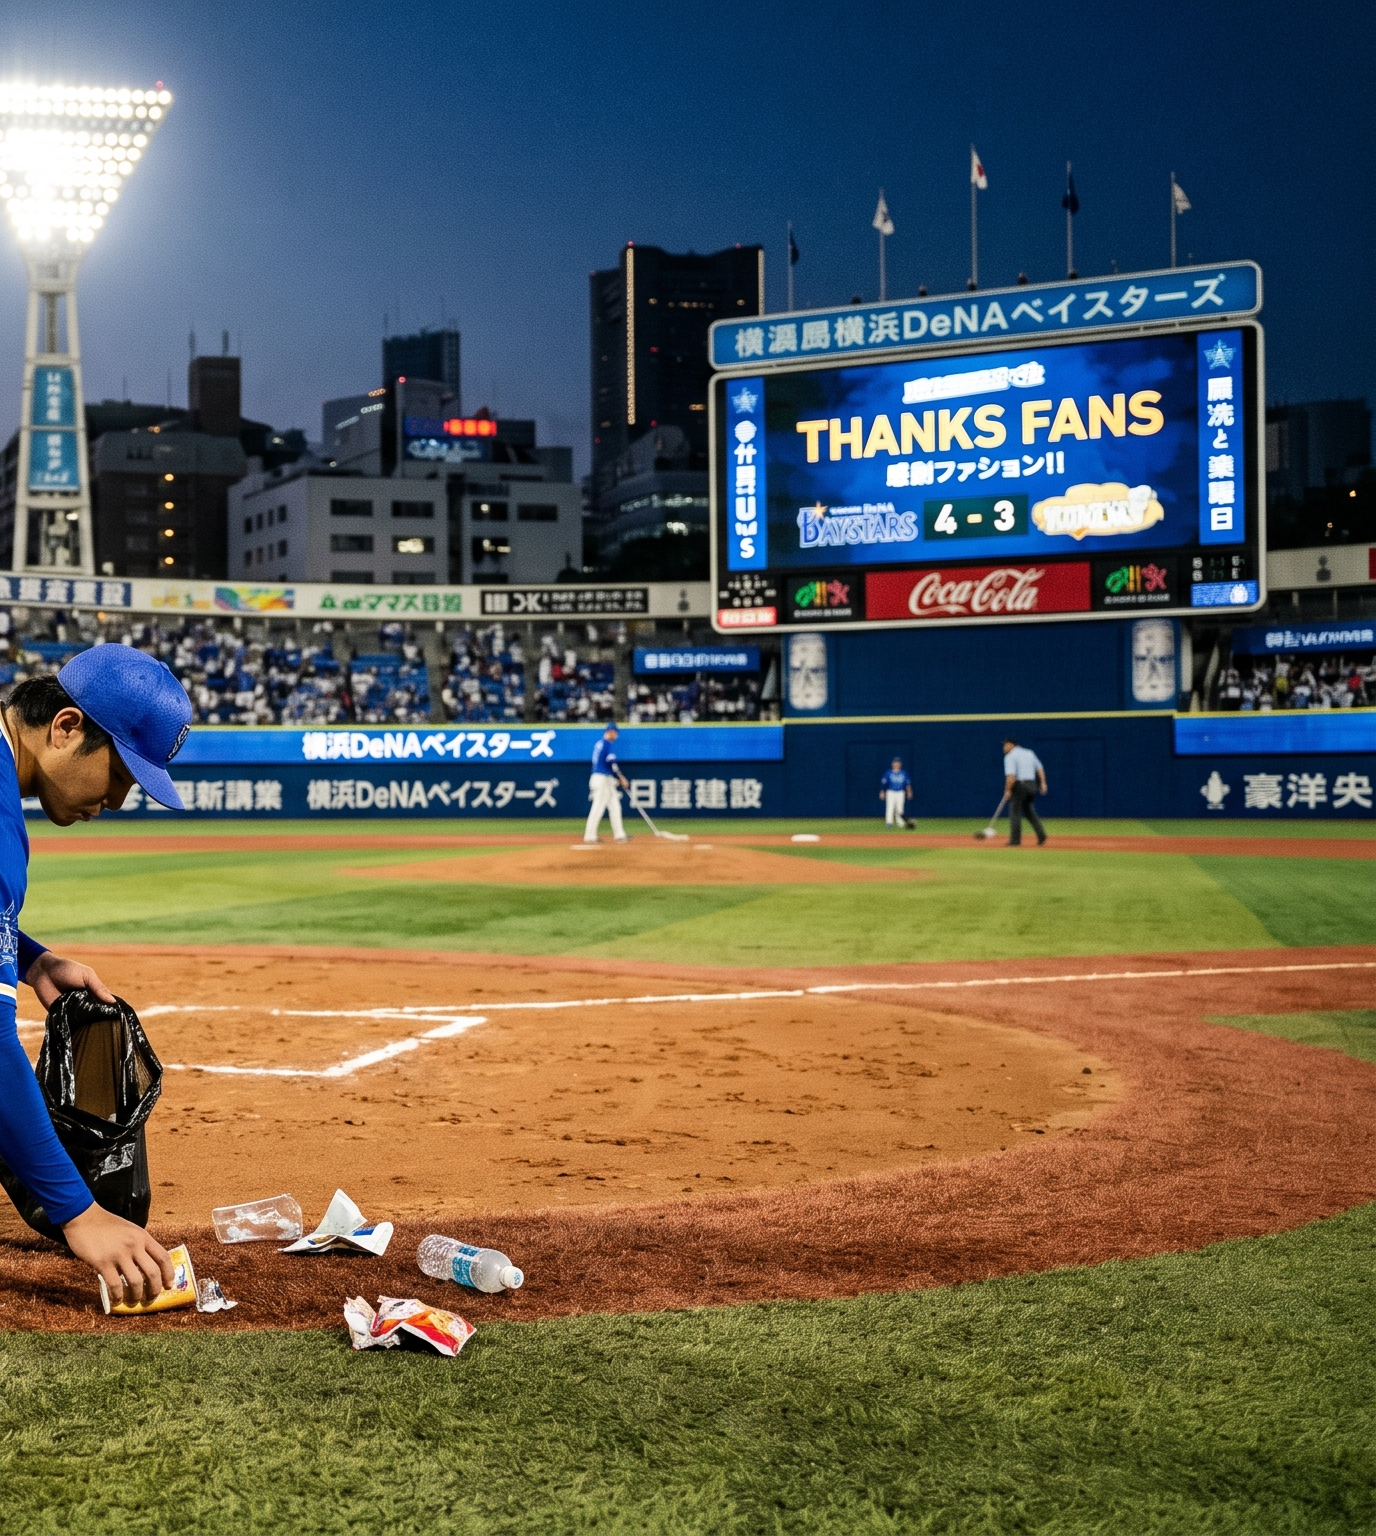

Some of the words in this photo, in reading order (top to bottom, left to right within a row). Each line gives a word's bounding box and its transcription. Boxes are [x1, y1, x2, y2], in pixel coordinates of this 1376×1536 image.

[796, 404, 1007, 463] THANKS
[1022, 390, 1165, 444] FANS
[797, 506, 919, 548] BAYSTARS
[934, 503, 958, 534] 4
[993, 500, 1016, 532] 3
[908, 567, 1046, 616] Coca-Cola
[302, 730, 557, 760] 横浜DeNAベイスターズ
[306, 778, 560, 811] 横浜DeNAベイスターズ
